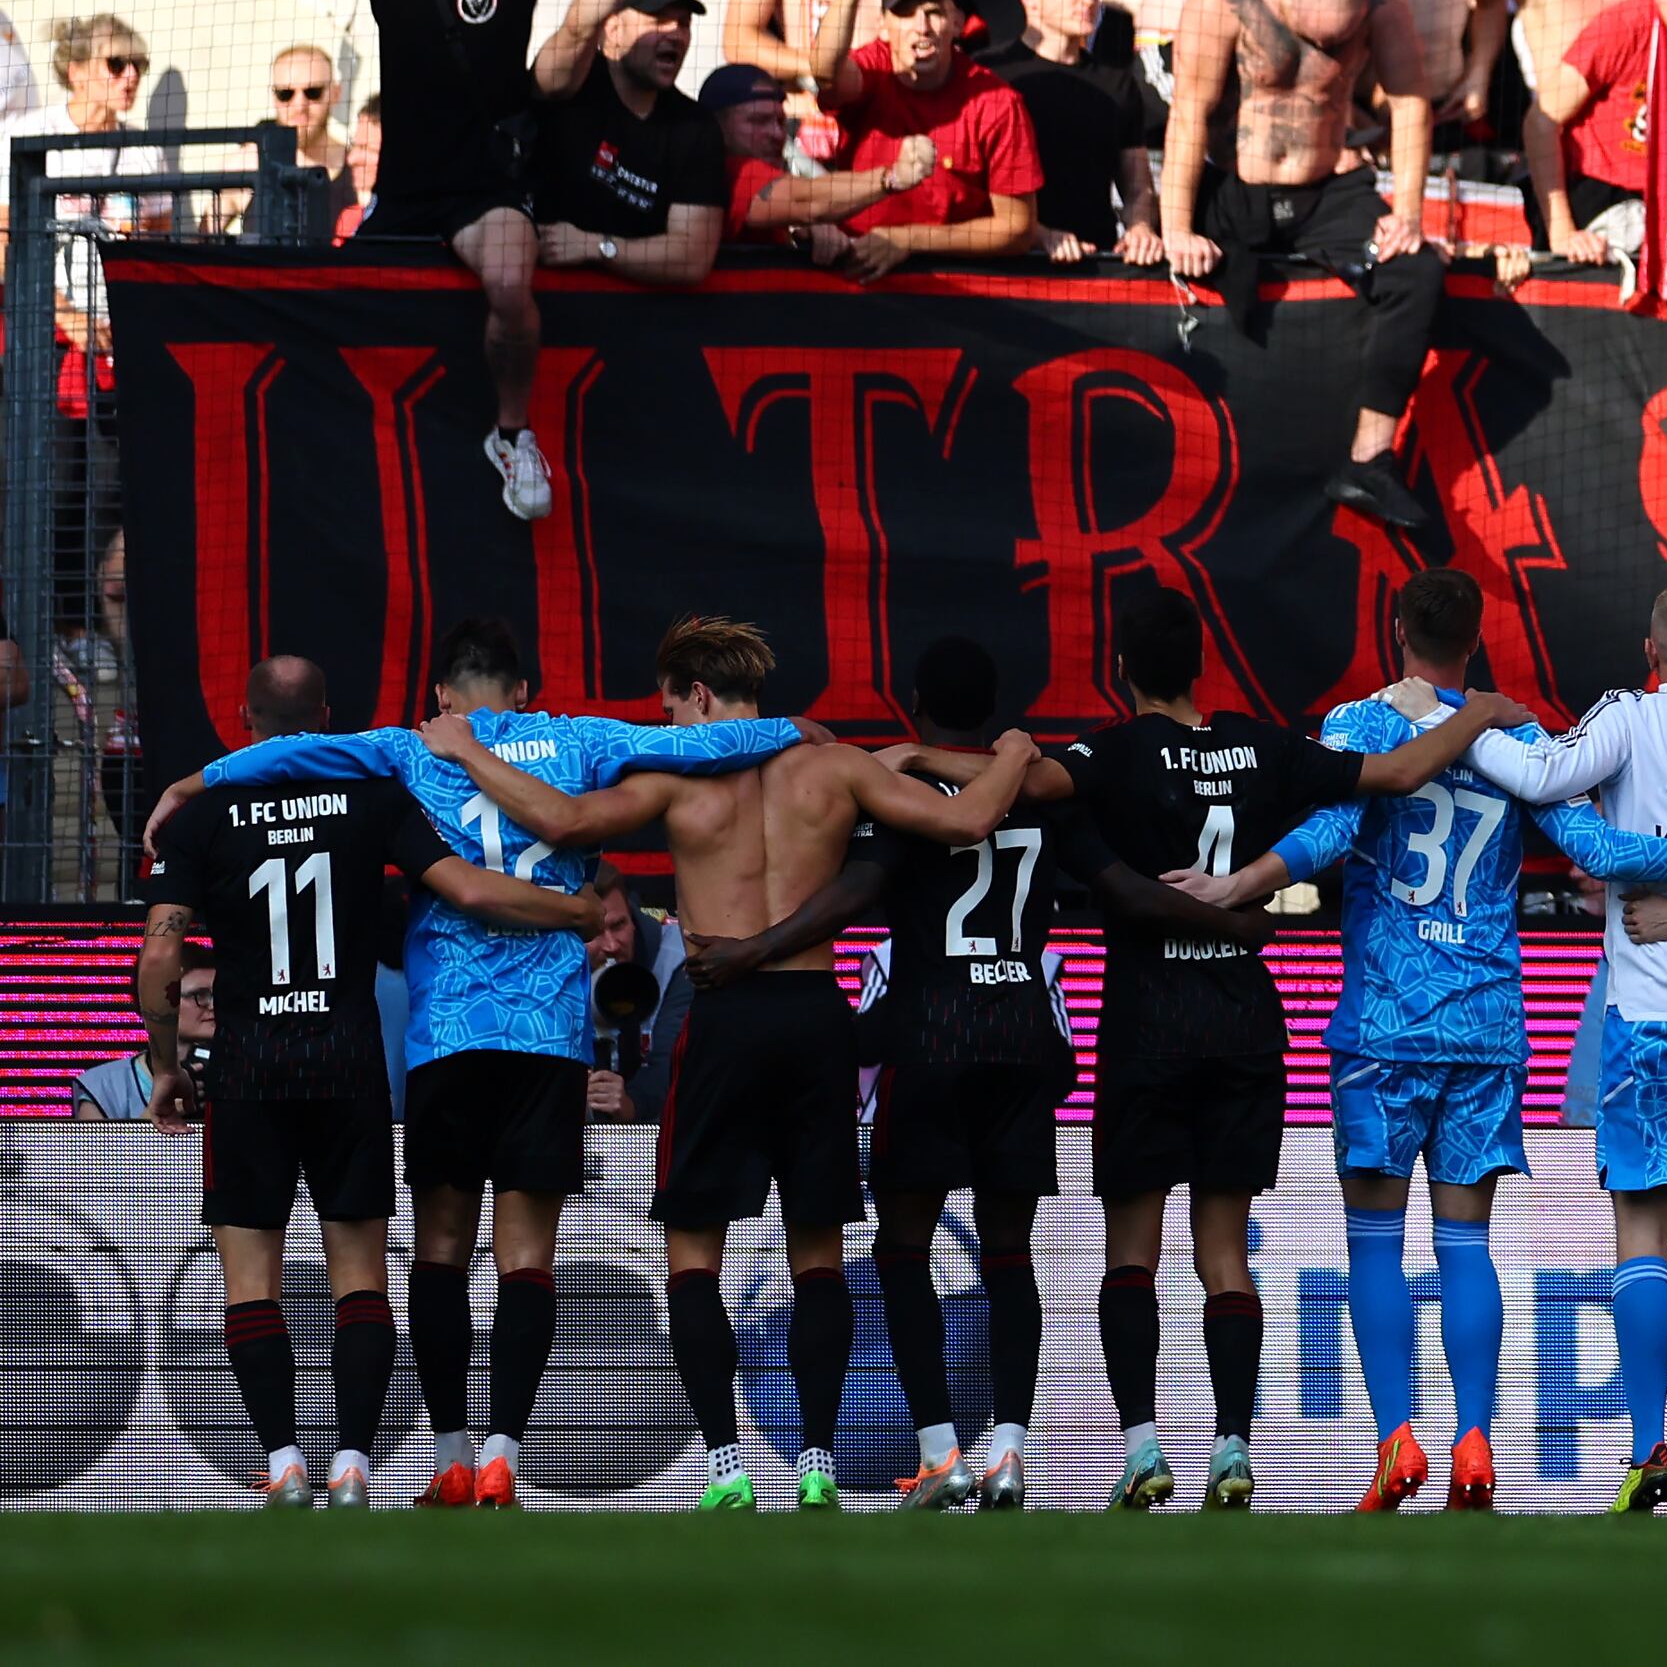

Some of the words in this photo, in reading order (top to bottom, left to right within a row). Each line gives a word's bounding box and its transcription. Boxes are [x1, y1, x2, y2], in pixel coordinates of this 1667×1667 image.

[1160, 747, 1178, 770] 1.
[1201, 746, 1257, 775] UNION
[1194, 780, 1232, 796] BERLIN
[228, 803, 246, 828] 1.
[250, 801, 277, 825] FC
[282, 794, 348, 820] UNION
[267, 827, 314, 846] BERLIN
[1390, 781, 1508, 917] 37
[946, 828, 1043, 956] 27
[248, 851, 336, 985] 11
[1418, 919, 1466, 944] GRILL
[259, 990, 330, 1016] MICHEL
